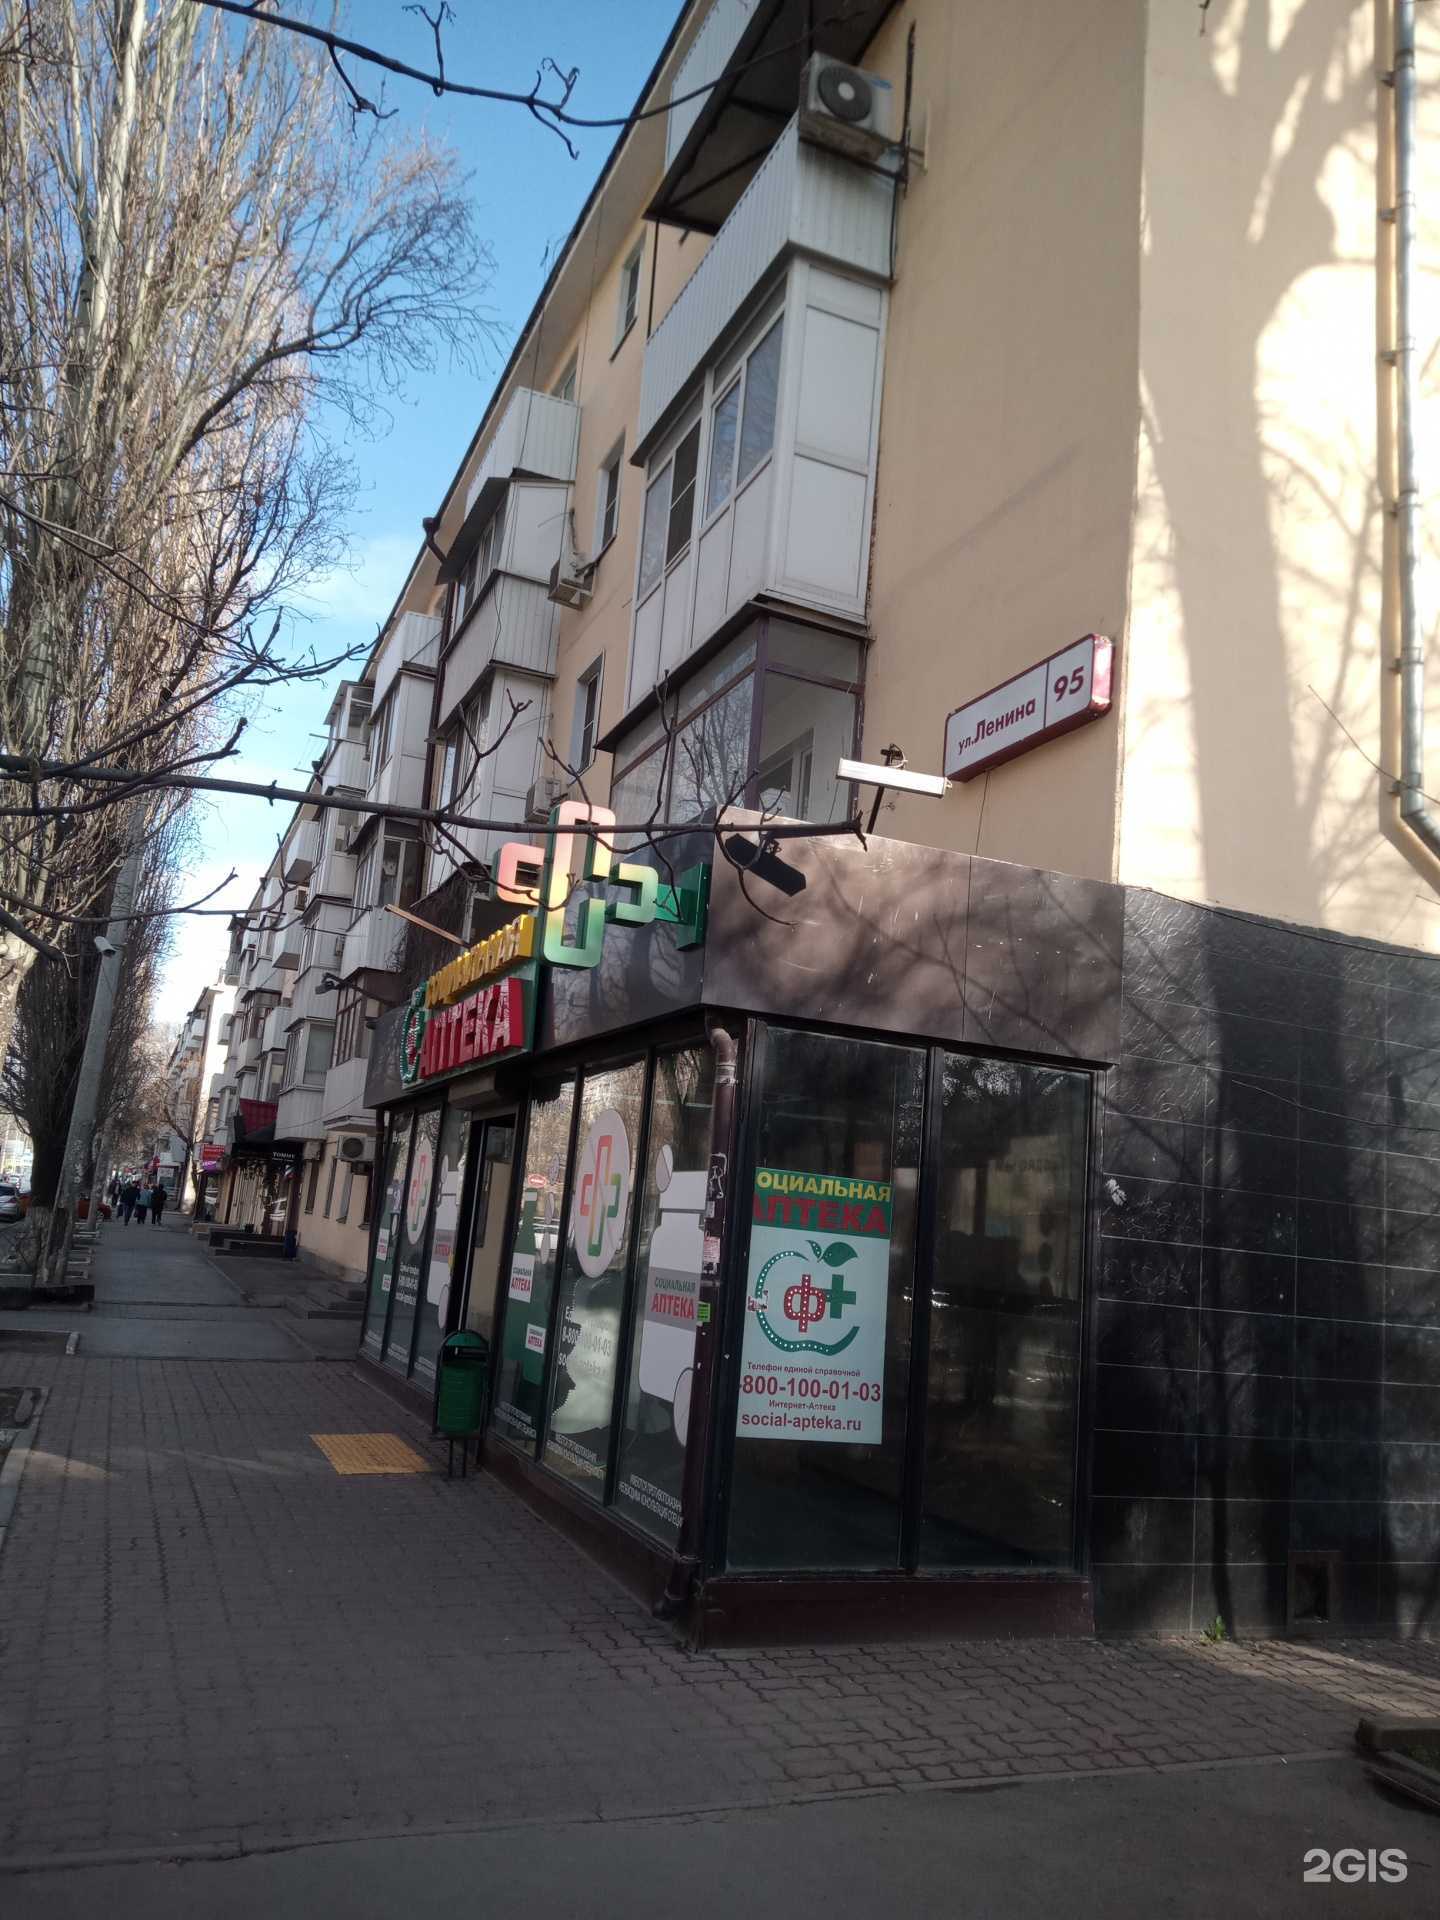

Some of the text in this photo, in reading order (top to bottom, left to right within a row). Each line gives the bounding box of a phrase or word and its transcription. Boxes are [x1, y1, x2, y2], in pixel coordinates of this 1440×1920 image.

[1053, 666, 1085, 702] 95
[419, 976, 523, 1079] АПТЕКА
[756, 1171, 891, 1202] ОЦИАЛЬНАЯ
[651, 1293, 694, 1320] АПТЕКА
[748, 1361, 861, 1378] Телефон единой справочной
[742, 1412, 861, 1432] social-apteka.ru
